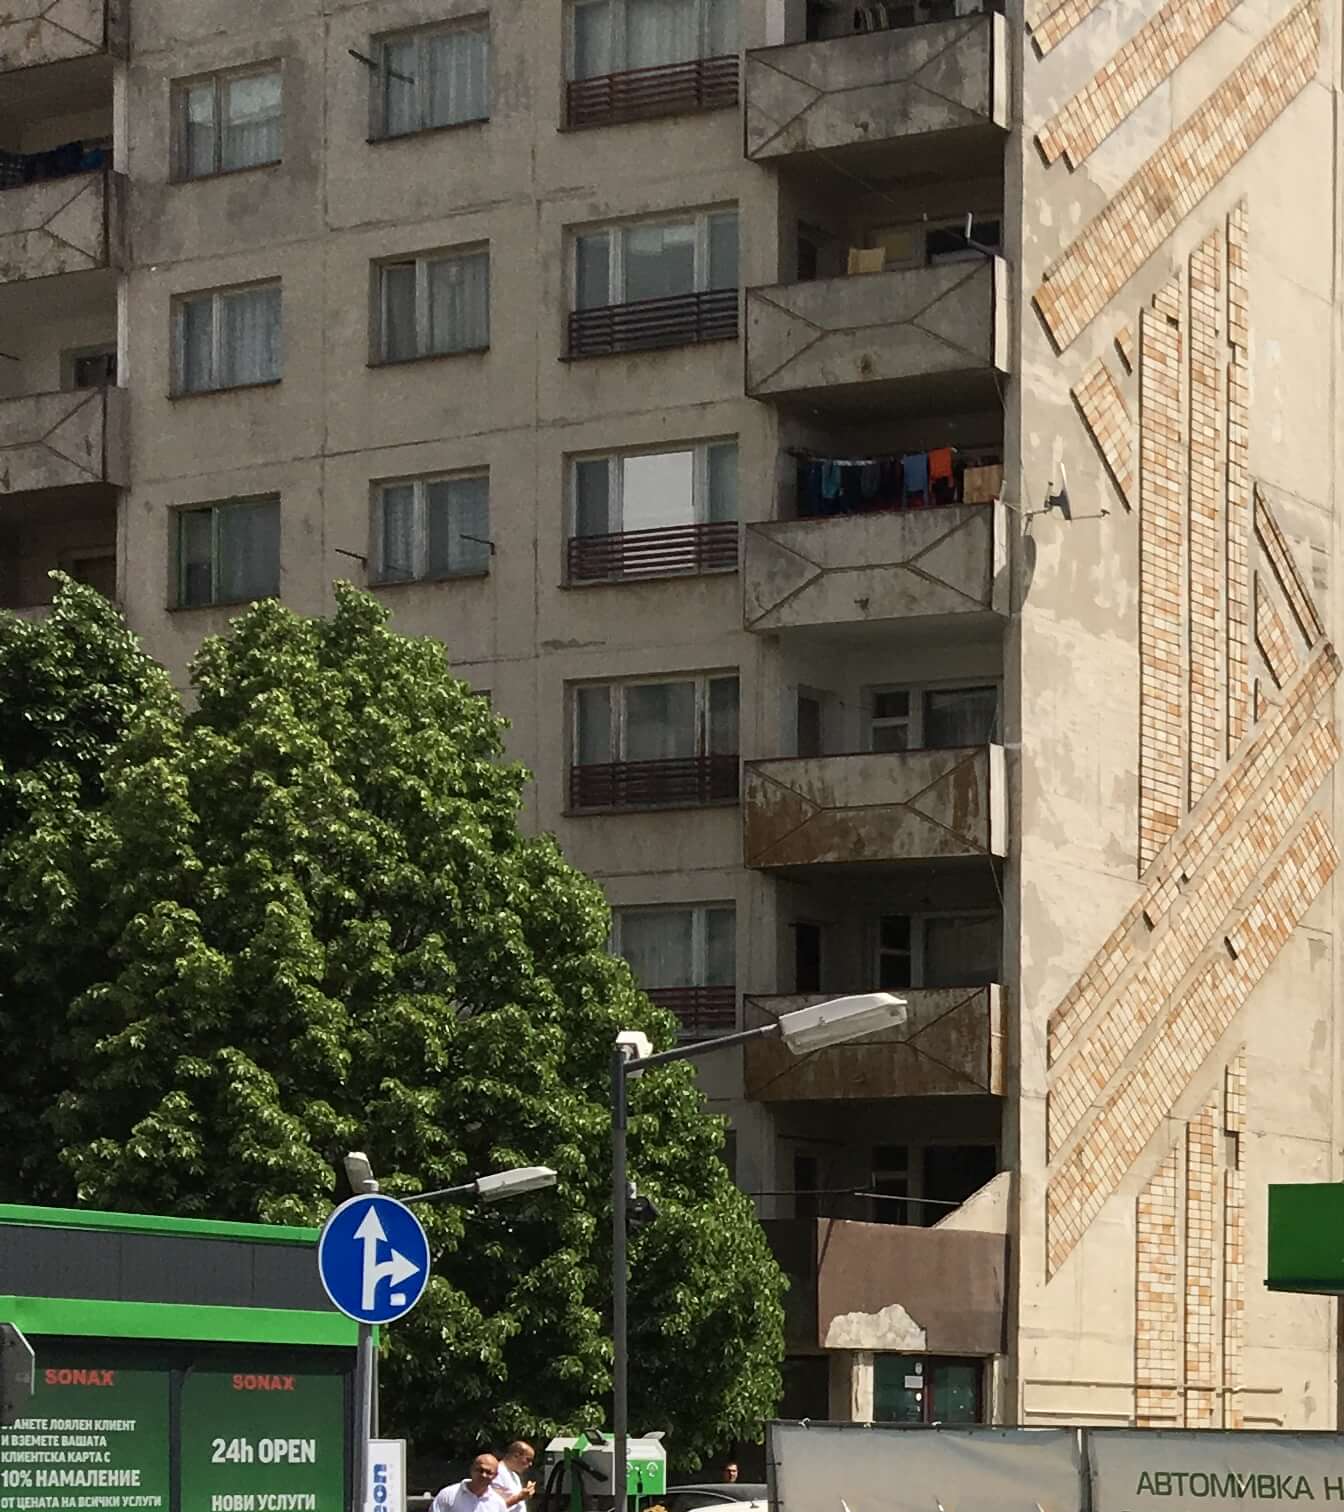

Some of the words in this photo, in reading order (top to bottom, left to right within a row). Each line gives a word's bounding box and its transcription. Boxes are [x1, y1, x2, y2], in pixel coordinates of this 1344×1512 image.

[46, 1370, 115, 1386] SONAX
[232, 1375, 295, 1391] SONAX
[1, 1418, 48, 1431] АНЕТЕ
[50, 1419, 92, 1431] ЛОЯЛЕН
[94, 1419, 136, 1432] КЛИЕНТ
[1, 1435, 9, 1446] И
[11, 1435, 59, 1447] ВЗЕМЕТЕ
[61, 1435, 107, 1447] ВАШАТА
[1, 1451, 66, 1463] КЛИЕНТСКА
[68, 1451, 102, 1463] КАРТА
[104, 1452, 111, 1463] С
[211, 1438, 253, 1463] 24h
[258, 1438, 316, 1463] OPEN
[1, 1469, 32, 1487] 10%
[35, 1469, 141, 1487] НАМАЛЕНИЕ
[1136, 1471, 1315, 1500] АВТОМИВКА
[1, 1496, 15, 1508] ОТ
[17, 1496, 60, 1510] ЦЕНАТА
[62, 1496, 77, 1508] НА
[78, 1496, 121, 1508] ВСИЧКИ
[122, 1495, 161, 1507] УСЛУГИ
[212, 1494, 254, 1511] НОВИ
[257, 1494, 316, 1511] УСЛУГИ
